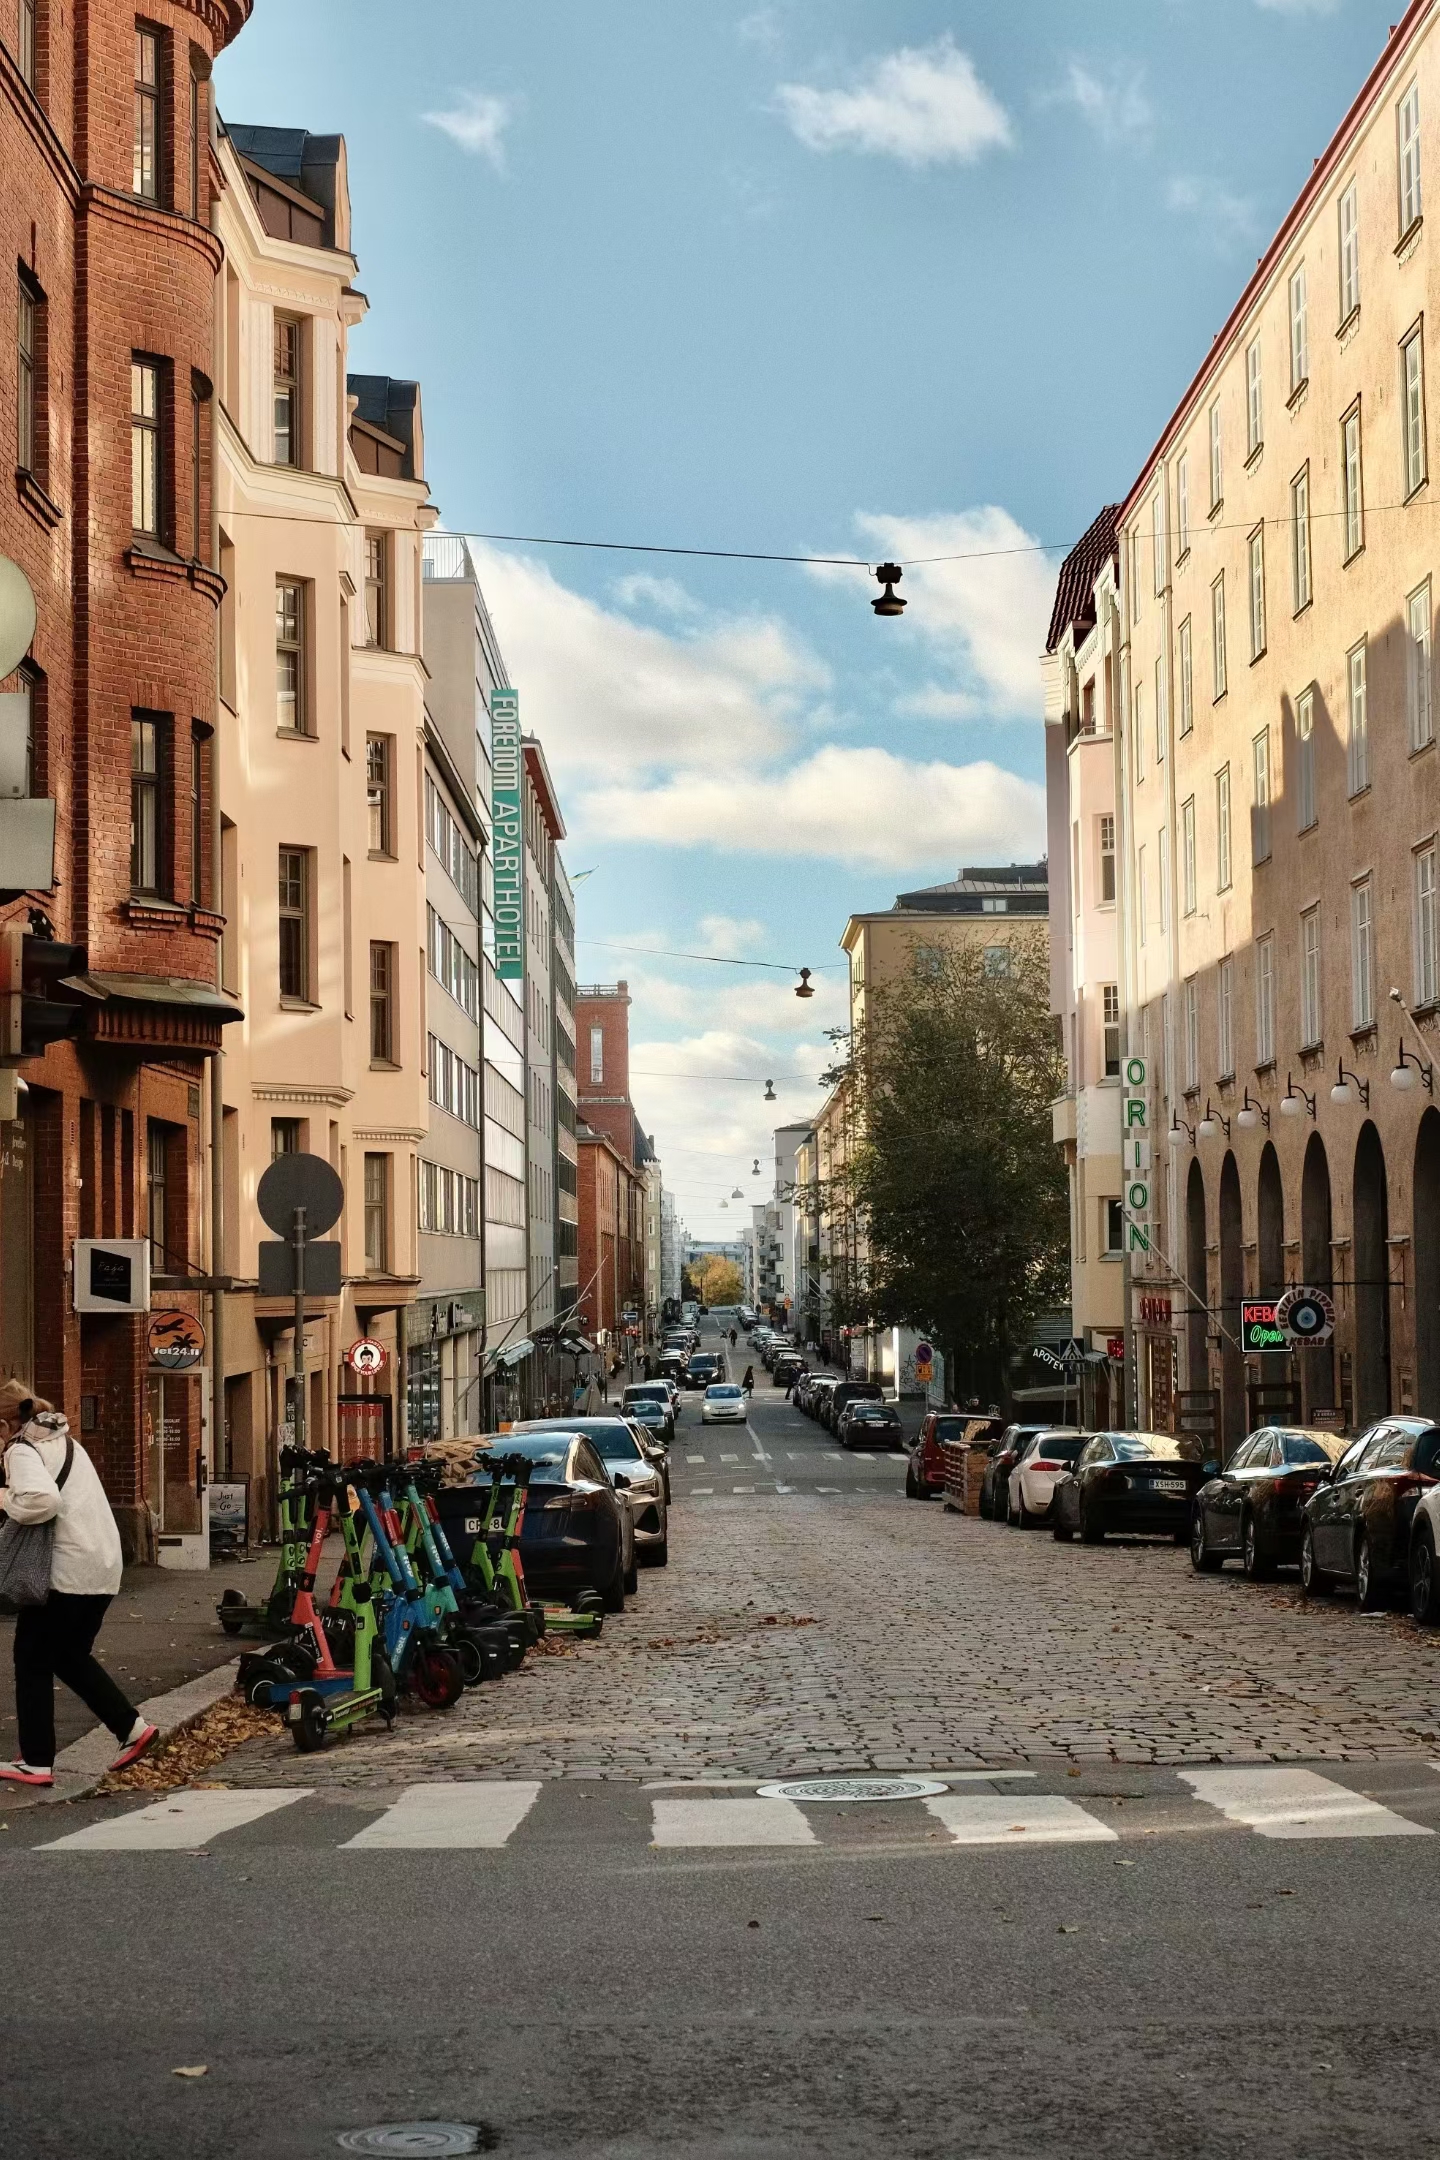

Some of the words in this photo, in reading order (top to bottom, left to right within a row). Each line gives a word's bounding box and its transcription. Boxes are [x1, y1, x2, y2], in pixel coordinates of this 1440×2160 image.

[493, 800, 522, 972] APARTHOTEL
[1127, 1058, 1149, 1252] ORION
[1278, 1288, 1305, 1330] EERIKIN
[1309, 1288, 1336, 1329] PIPPURI
[1250, 1324, 1284, 1348] Open
[1289, 1337, 1325, 1346] KEBAB
[153, 1347, 200, 1356] Jet24.fi
[1155, 1480, 1185, 1489] XSH-595
[217, 1491, 234, 1501] Just
[219, 1501, 231, 1511] Go
[395, 1636, 407, 1654] dott
